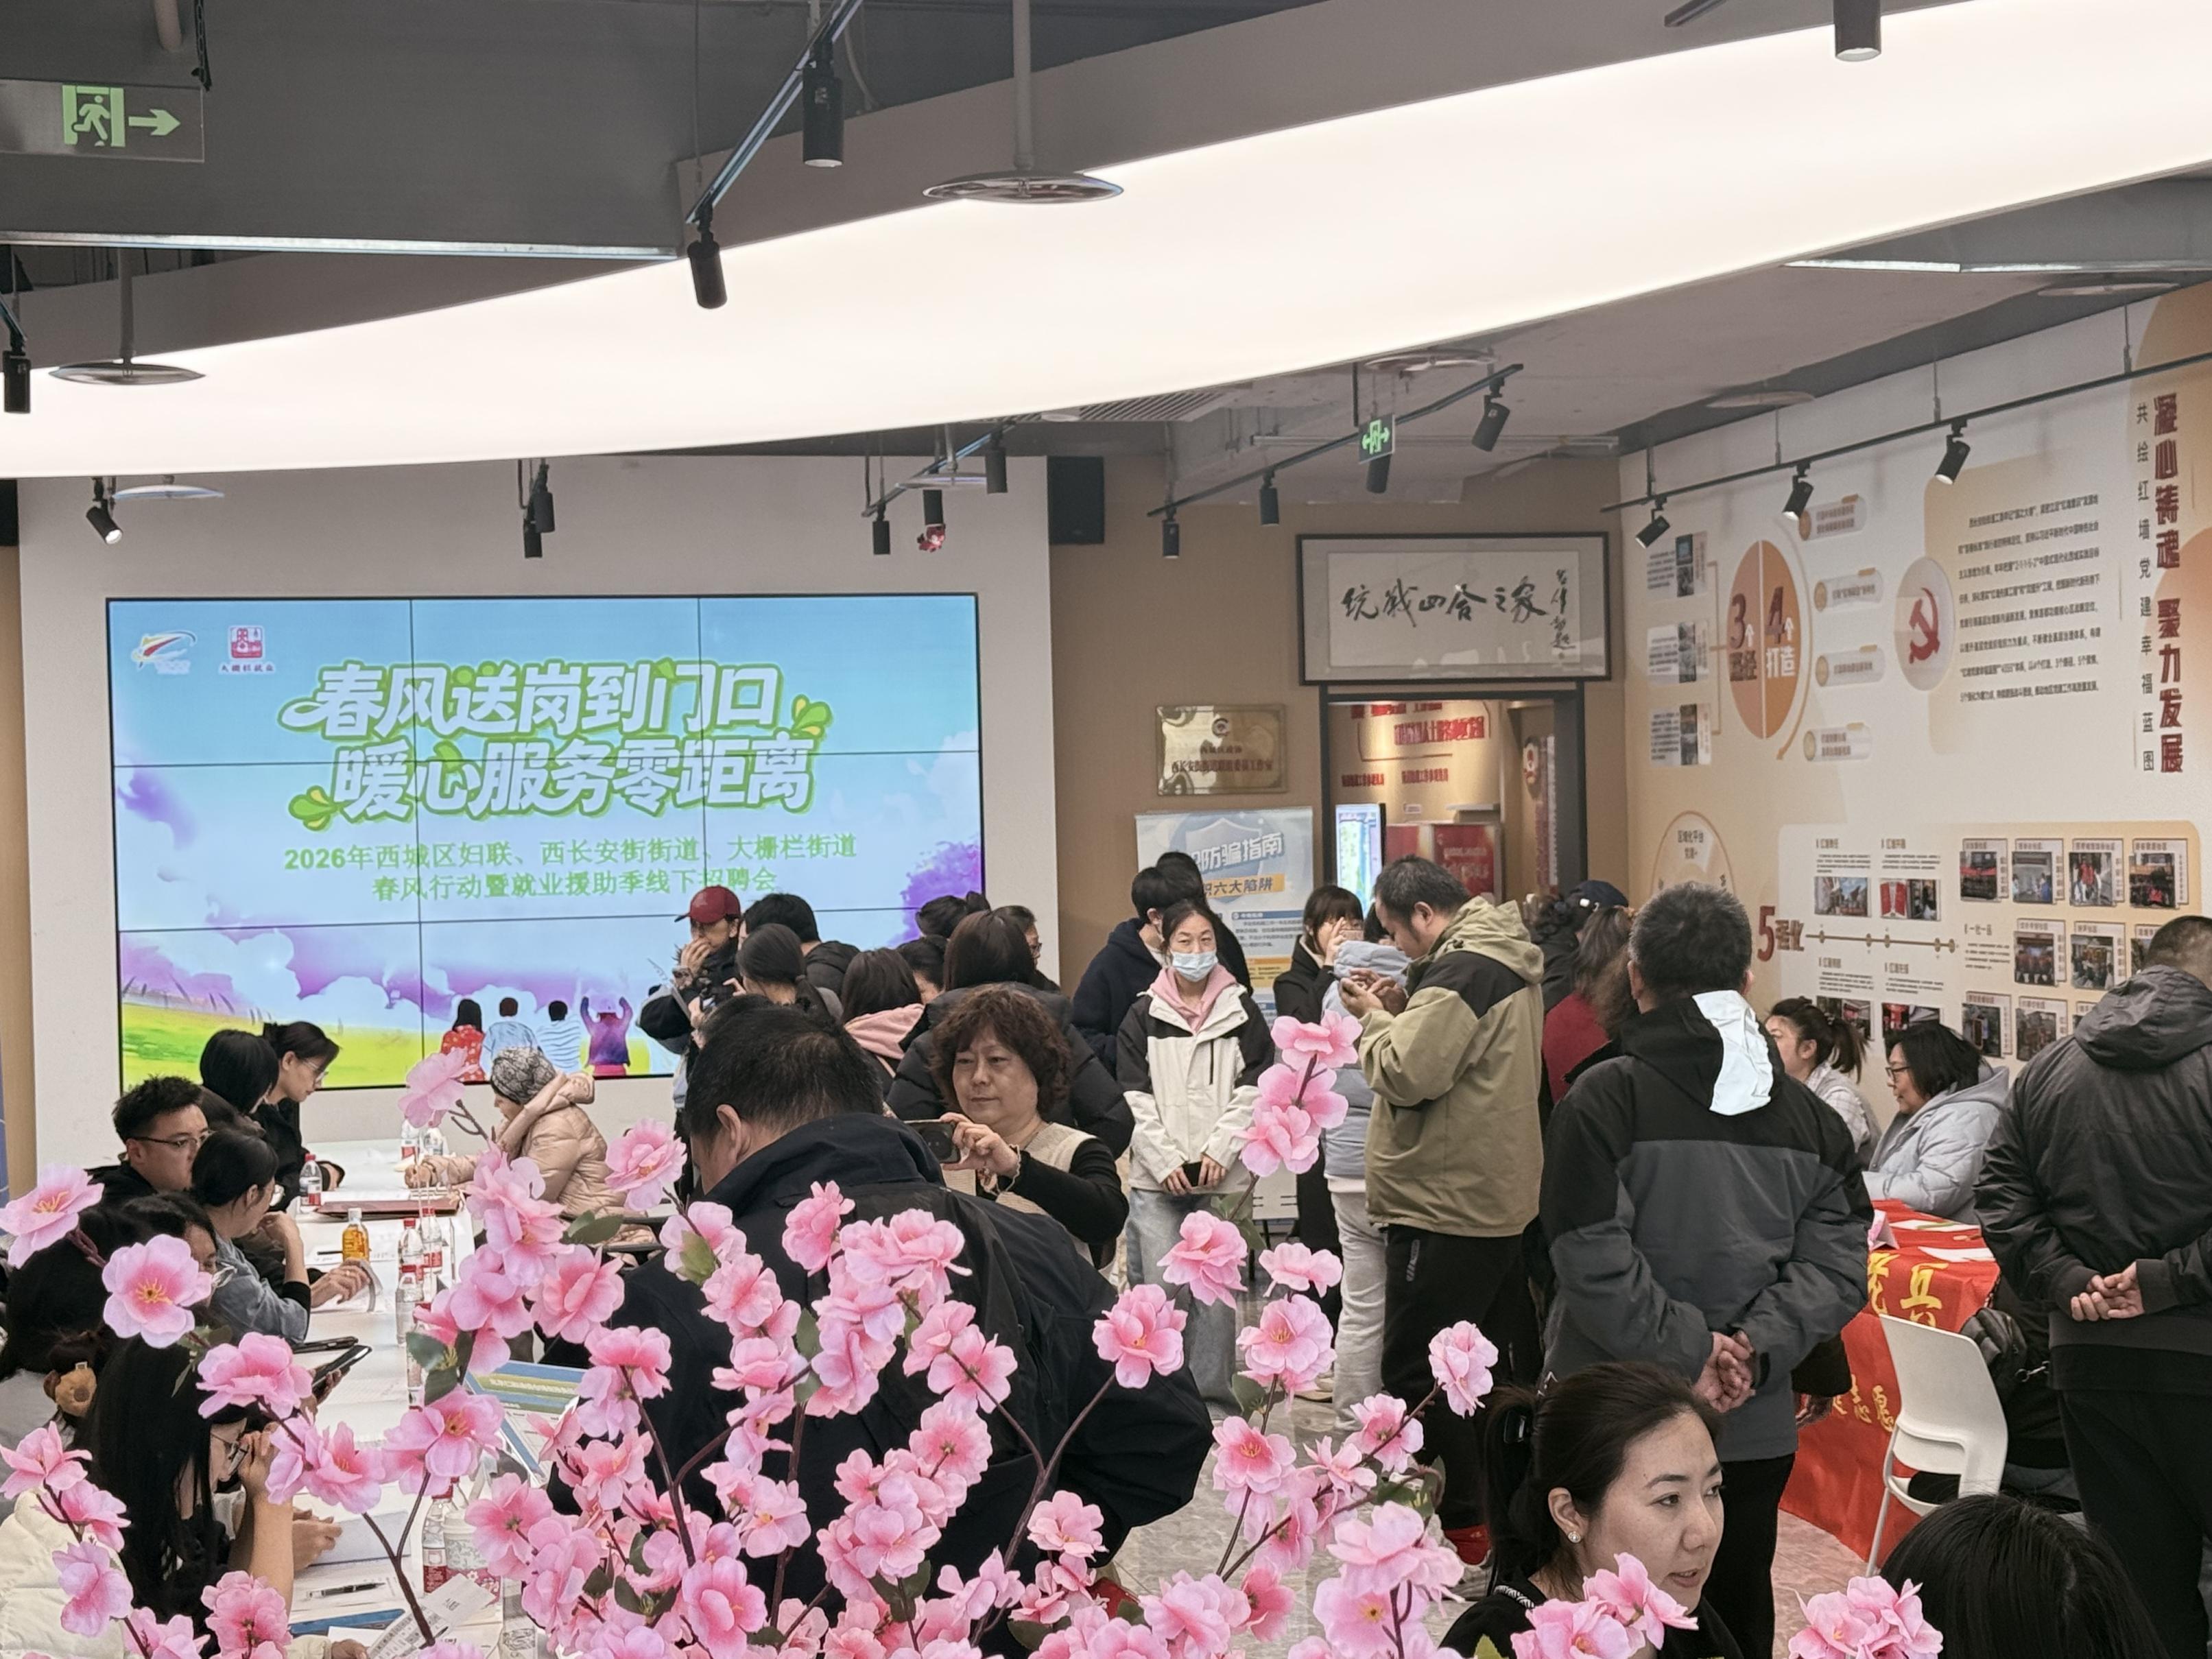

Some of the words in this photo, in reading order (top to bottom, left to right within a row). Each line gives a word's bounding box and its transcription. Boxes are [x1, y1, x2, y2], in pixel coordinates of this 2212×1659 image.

[2154, 393, 2179, 569] 凝心铸魂
[281, 662, 781, 737] 春风送岗到门口
[2156, 597, 2183, 774] 聚力发展
[333, 734, 815, 817] 暖心服务零距离
[372, 867, 777, 901] 春风行动暨就业援助季线下招聘会
